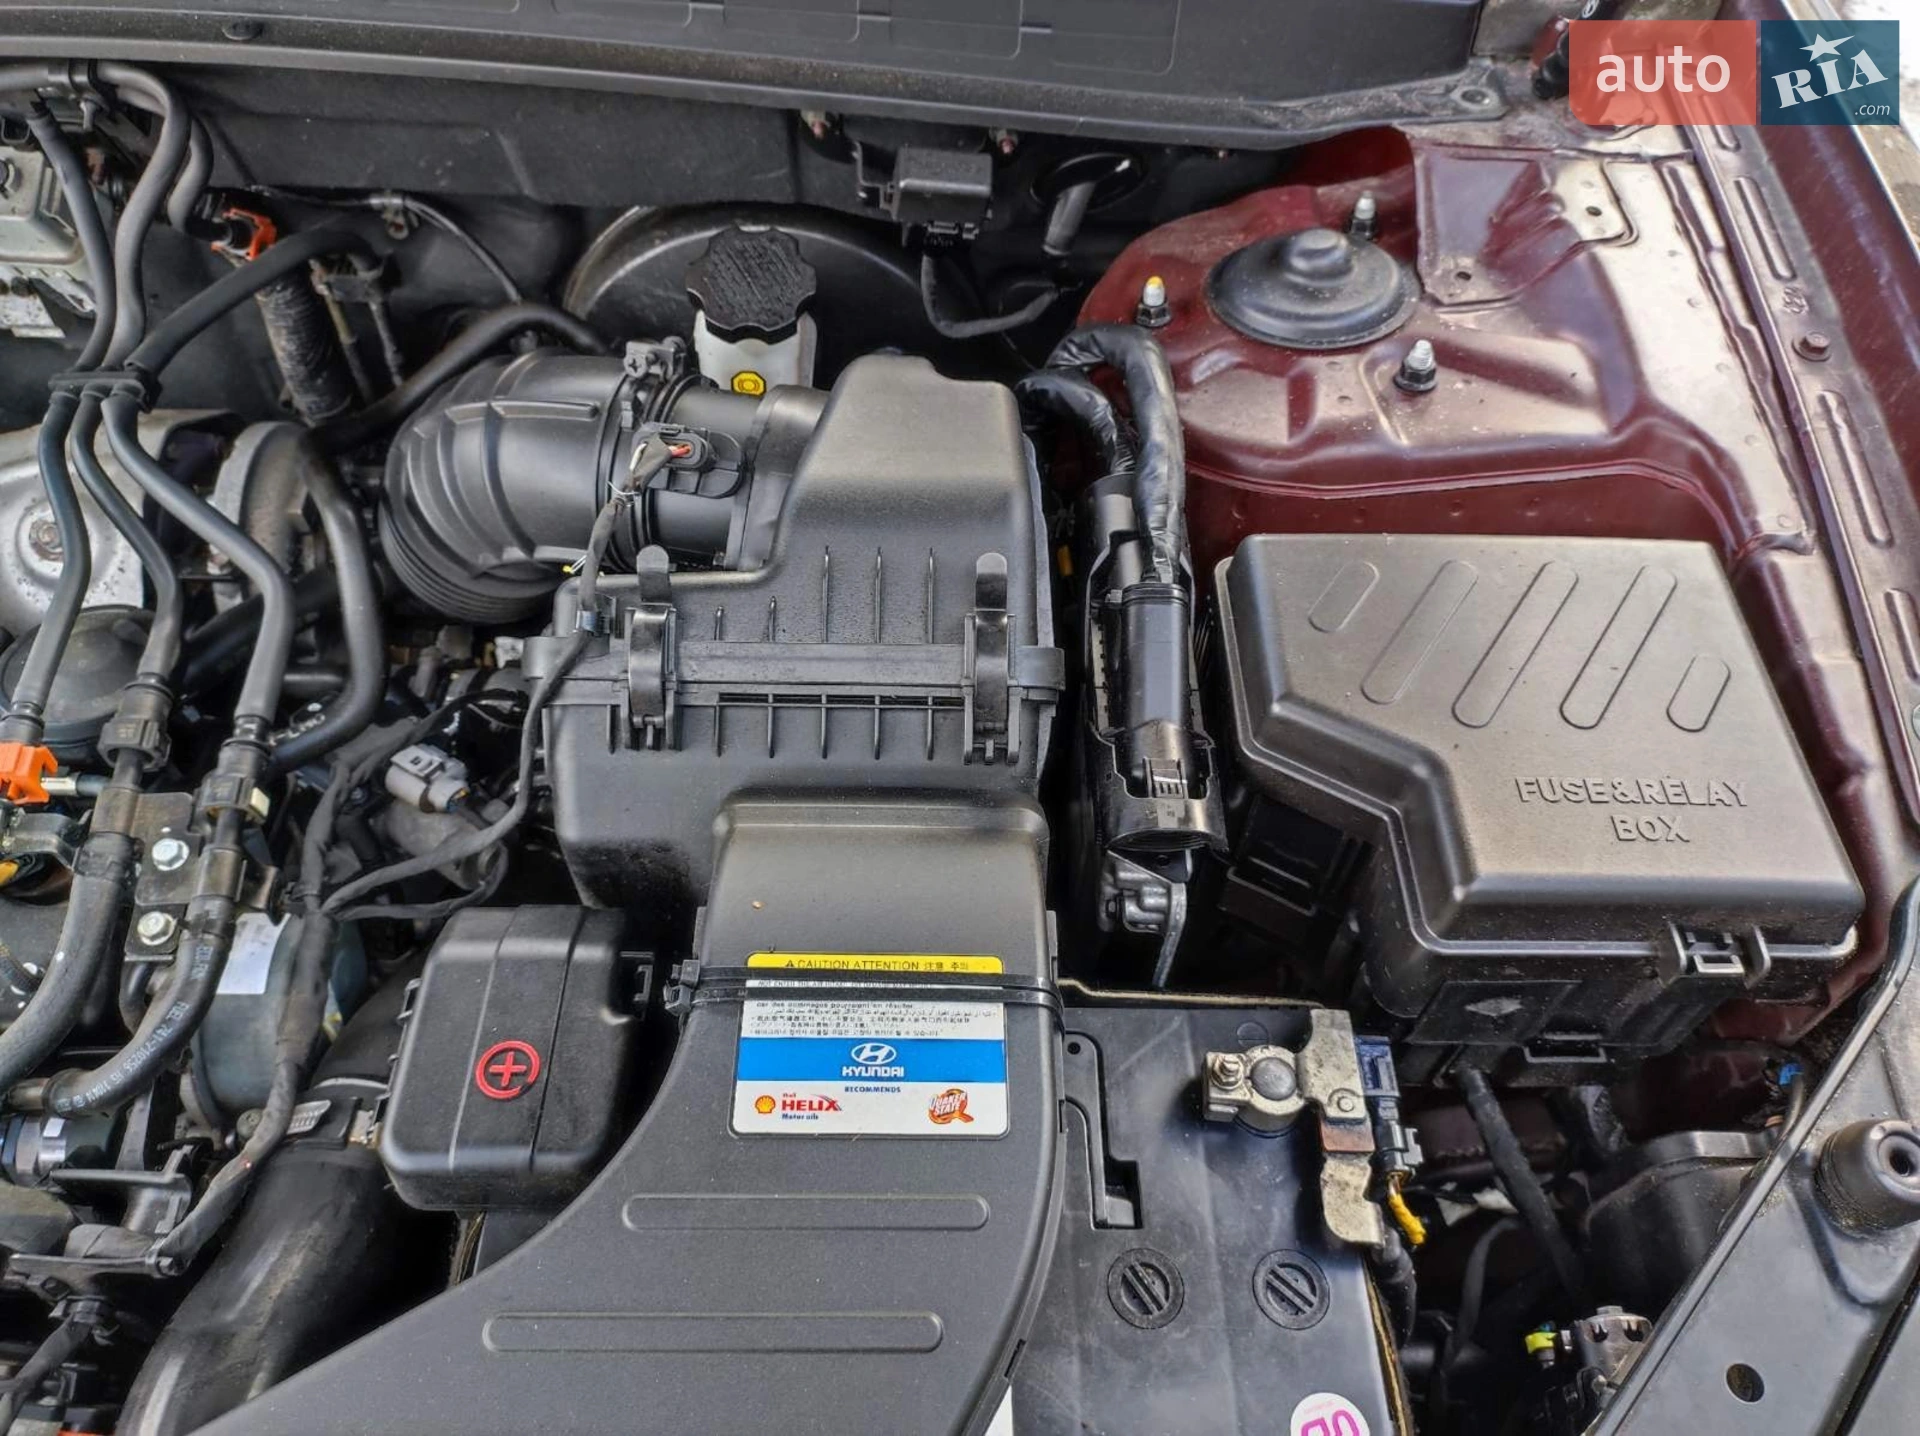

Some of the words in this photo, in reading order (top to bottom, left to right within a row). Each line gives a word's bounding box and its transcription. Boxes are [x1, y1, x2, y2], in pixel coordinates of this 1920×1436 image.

[1515, 777, 1748, 806] FUSE&RELAY
[1610, 815, 1690, 842] BOX
[797, 959, 849, 969] CAUTION
[853, 960, 919, 971] ATTENTION
[842, 1066, 905, 1078] HYUNDAI
[844, 1085, 901, 1093] RECOMMENDS
[781, 1099, 841, 1112] HELIX
